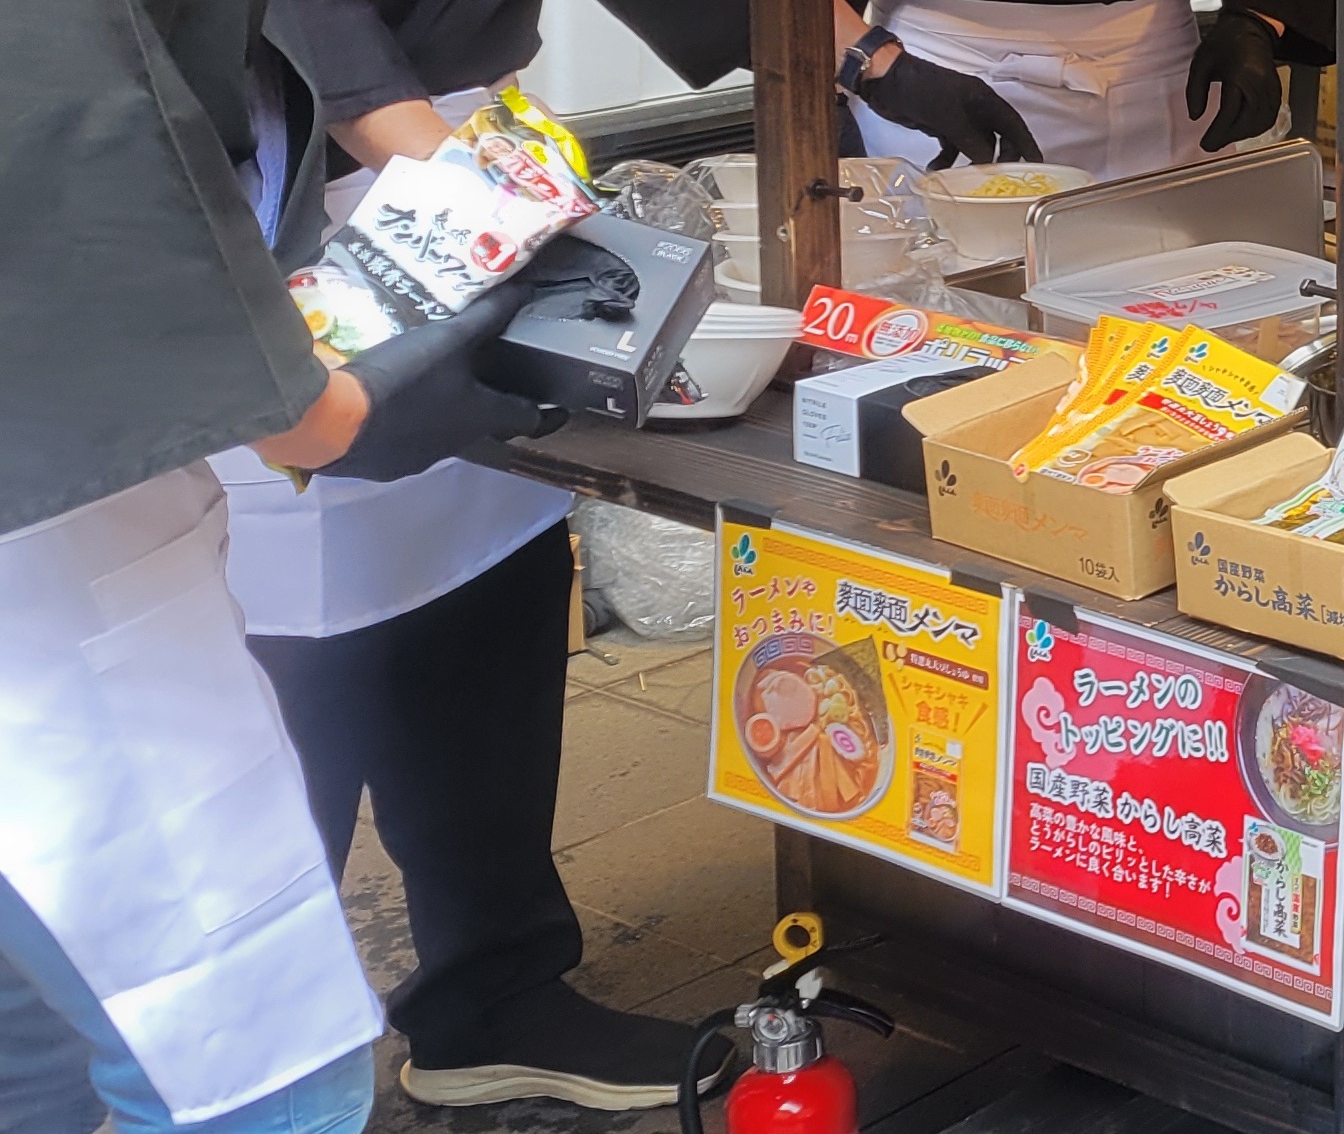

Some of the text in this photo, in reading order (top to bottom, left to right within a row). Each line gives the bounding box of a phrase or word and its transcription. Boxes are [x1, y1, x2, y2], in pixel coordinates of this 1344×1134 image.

[616, 330, 638, 353] L
[1078, 556, 1120, 583] 10袋入
[1217, 558, 1265, 584] 国産野菜
[731, 576, 817, 617] ラーメンや
[1214, 574, 1319, 622] からし高菜
[733, 609, 835, 648] おつまみに!
[901, 676, 969, 708] シャキシャキ
[1075, 669, 1202, 709] ラーメンの
[916, 700, 961, 732] 食感!
[1060, 713, 1228, 760] トッピングに!!
[1028, 764, 1227, 857] 国産野菜 からし高菜
[1029, 802, 1144, 854] 高菜の豊かな風味と、
[1029, 820, 1212, 893] とうがらしのピリッとした辛さが
[1029, 835, 1171, 898] ラーメンに良く合います!
[1273, 858, 1289, 939] からし高菜
